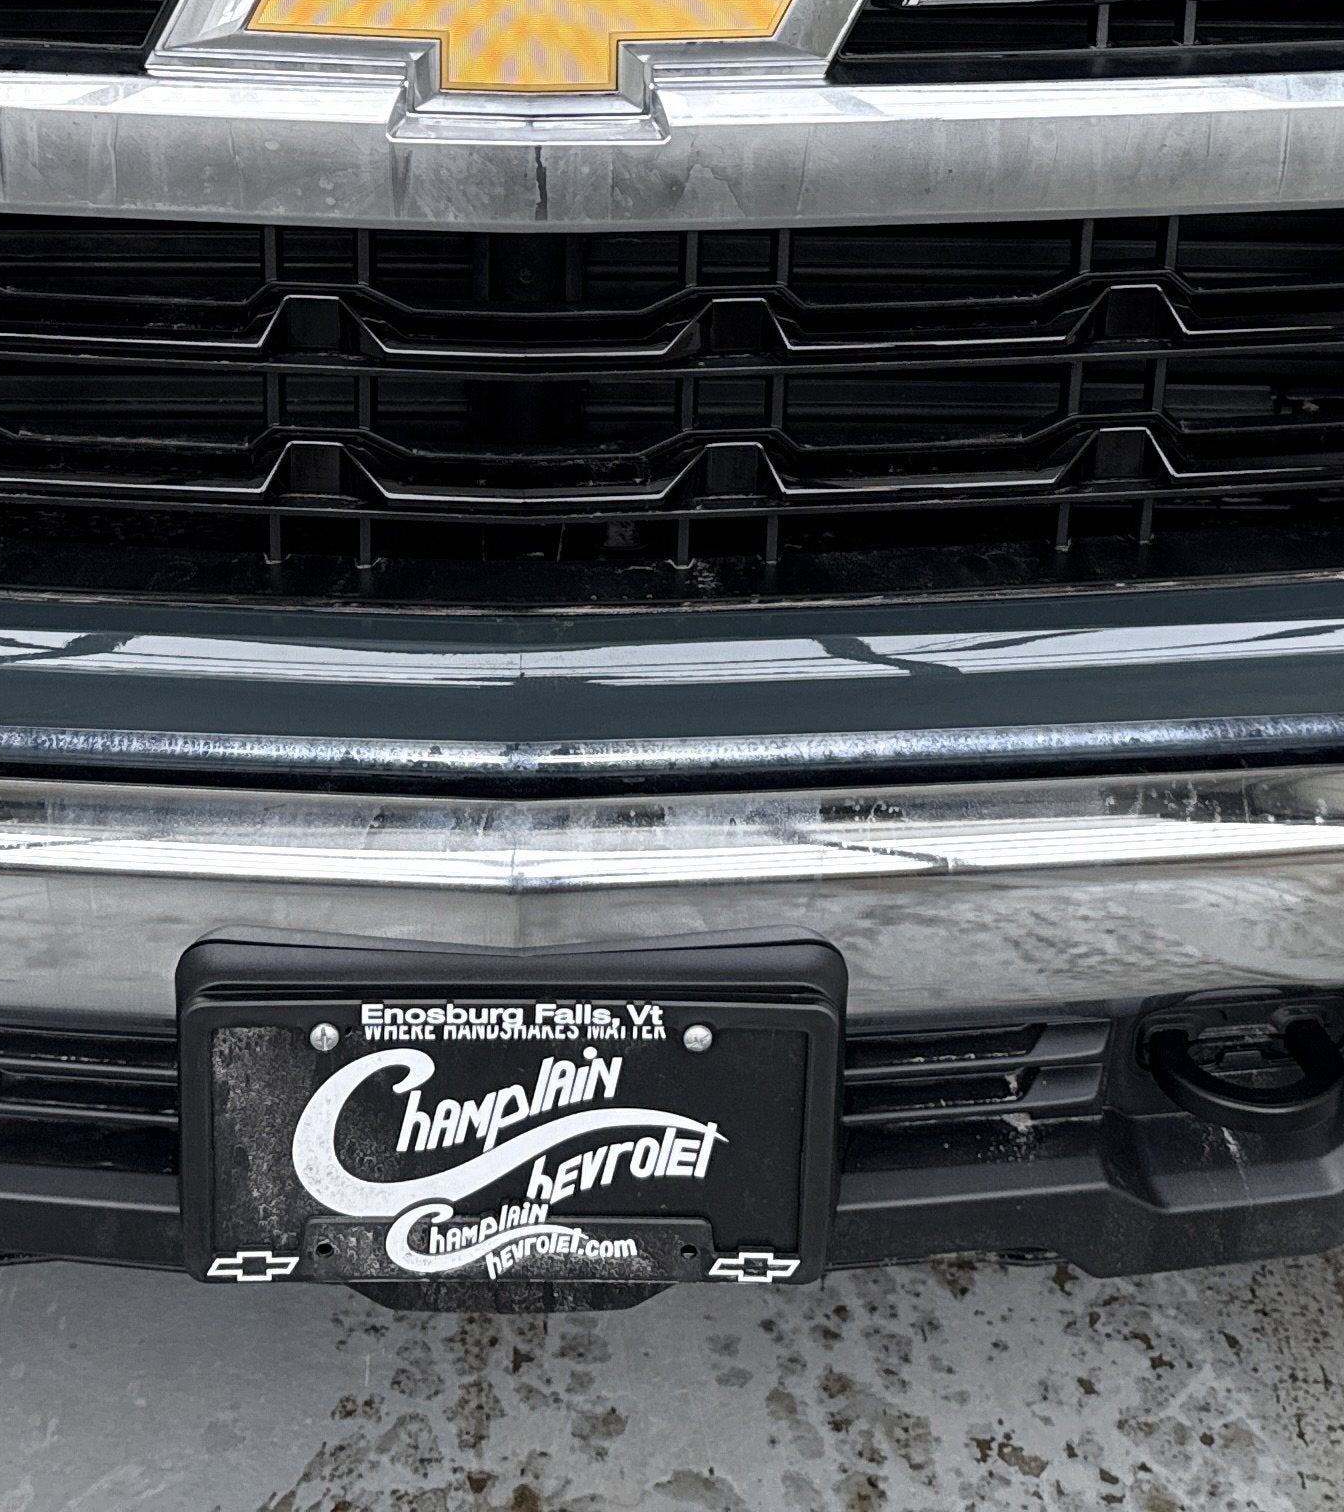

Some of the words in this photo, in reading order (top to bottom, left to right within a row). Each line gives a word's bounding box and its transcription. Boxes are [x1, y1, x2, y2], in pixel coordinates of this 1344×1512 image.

[360, 1002, 524, 1029] Enosburg
[534, 1002, 621, 1029] Falls,
[626, 1003, 664, 1026] Vt
